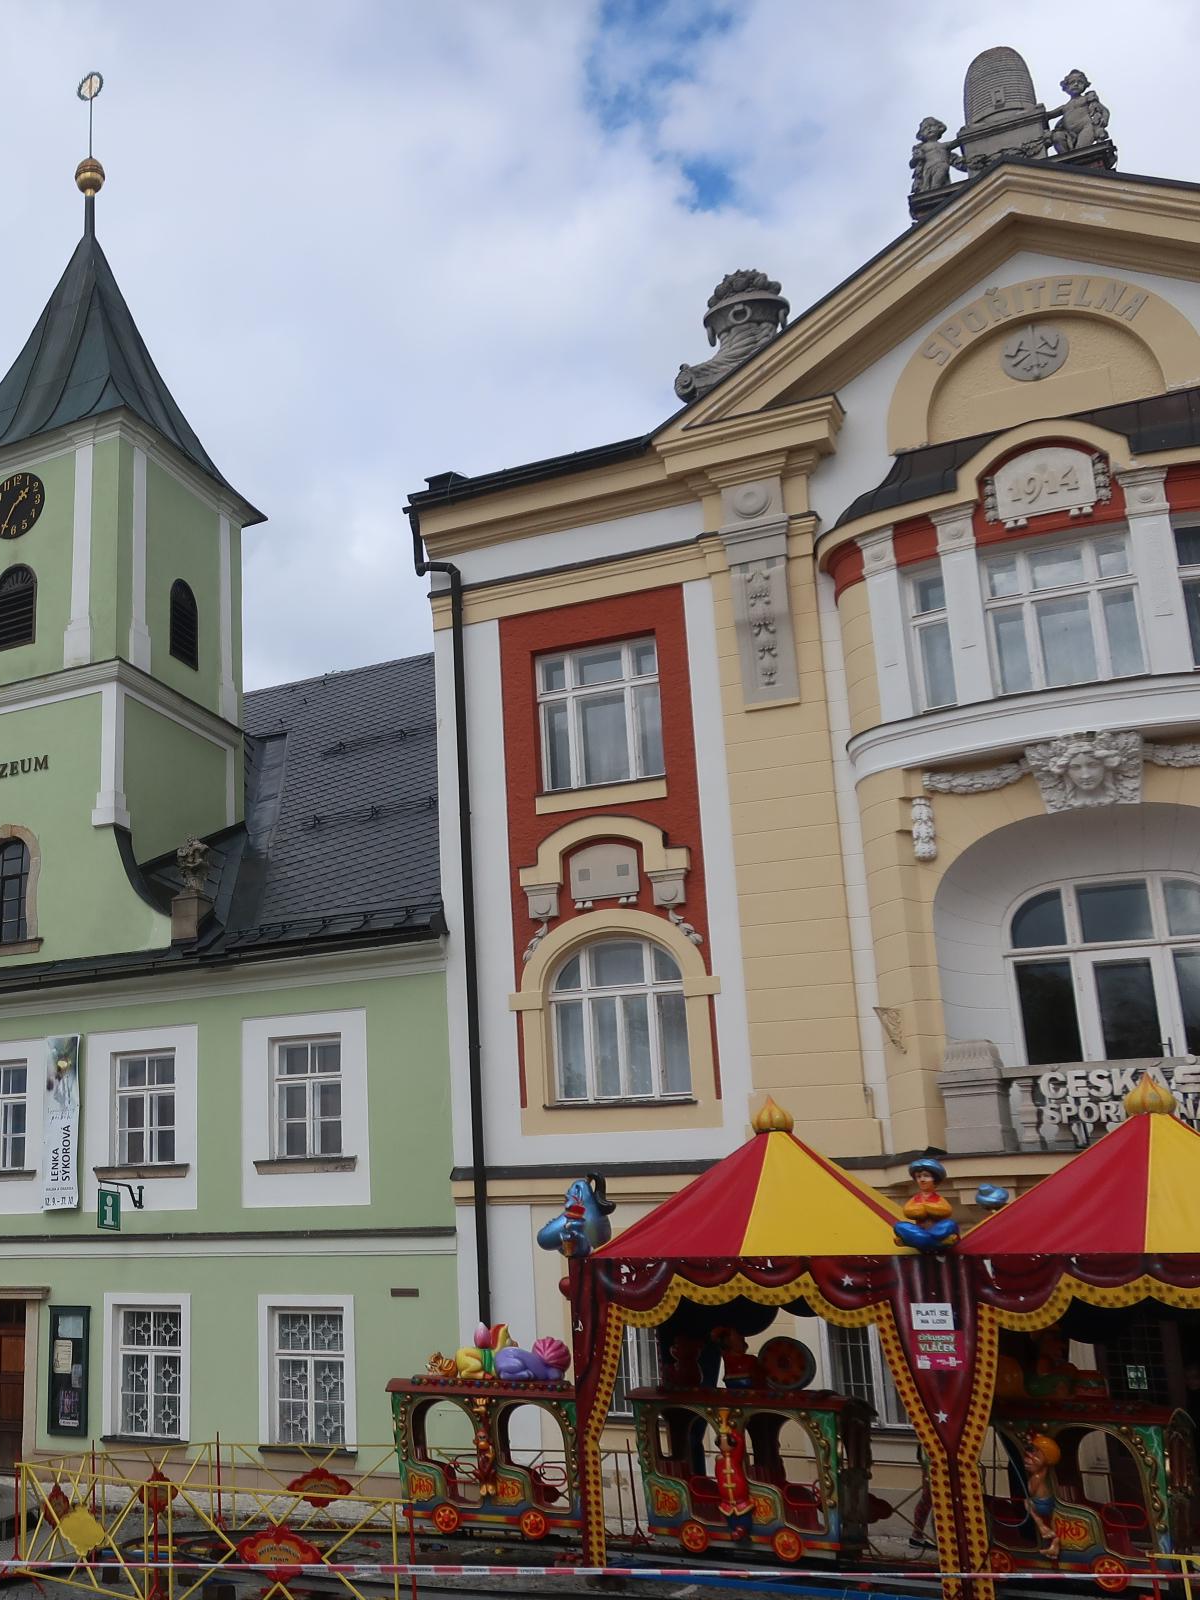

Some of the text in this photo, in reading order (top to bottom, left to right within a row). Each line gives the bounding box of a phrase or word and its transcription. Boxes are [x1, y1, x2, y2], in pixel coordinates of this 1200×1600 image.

[922, 279, 1149, 366] SPOŘITELNA
[13, 475, 22, 487] 12
[33, 481, 39, 492] 2
[1006, 465, 1080, 505] 1914
[34, 494, 41, 504] 3
[10, 525, 17, 535] 6
[21, 519, 28, 529] 5
[60, 1124, 71, 1182] SÝKOROVÁ
[50, 1147, 59, 1182] LENKA
